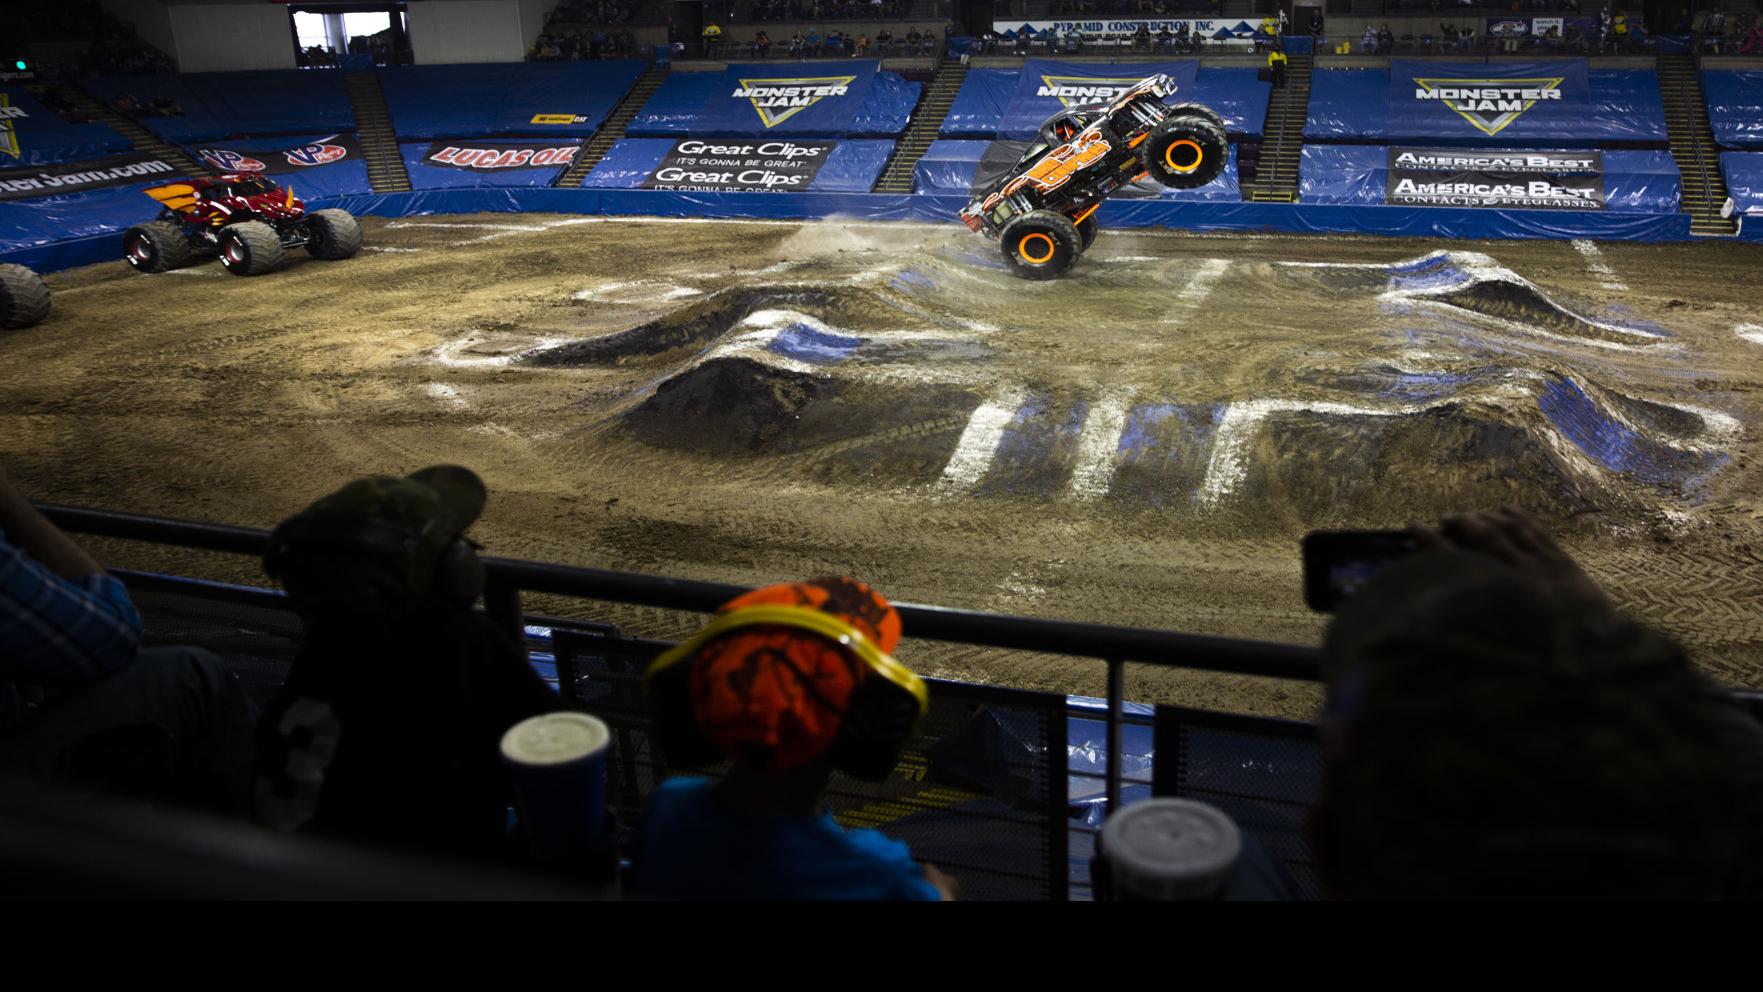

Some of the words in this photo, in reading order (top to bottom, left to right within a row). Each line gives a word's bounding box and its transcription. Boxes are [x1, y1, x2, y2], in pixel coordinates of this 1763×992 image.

[732, 86, 848, 98] MONSTER
[1037, 86, 1131, 98] MONST
[1416, 88, 1561, 99] MONSTER
[758, 96, 812, 107] JAM
[1456, 99, 1521, 111] JAM
[283, 144, 325, 165] VP
[430, 146, 534, 168] LUCAS
[529, 145, 581, 166] OIL
[677, 141, 753, 156] Great
[757, 142, 821, 160] Clips
[676, 158, 696, 166] IT'S
[699, 159, 740, 167] GONNA
[744, 160, 760, 168] BE
[764, 160, 803, 168] GREAT
[1395, 152, 1524, 167] AMERICA'S
[1527, 156, 1594, 168] BEST
[0, 160, 174, 193] terJam.com
[655, 167, 733, 184] Great
[737, 170, 803, 188] Clips
[1393, 178, 1526, 197] AMERICA'S
[1528, 181, 1595, 199] BEST
[1393, 195, 1479, 205] CONTACTS
